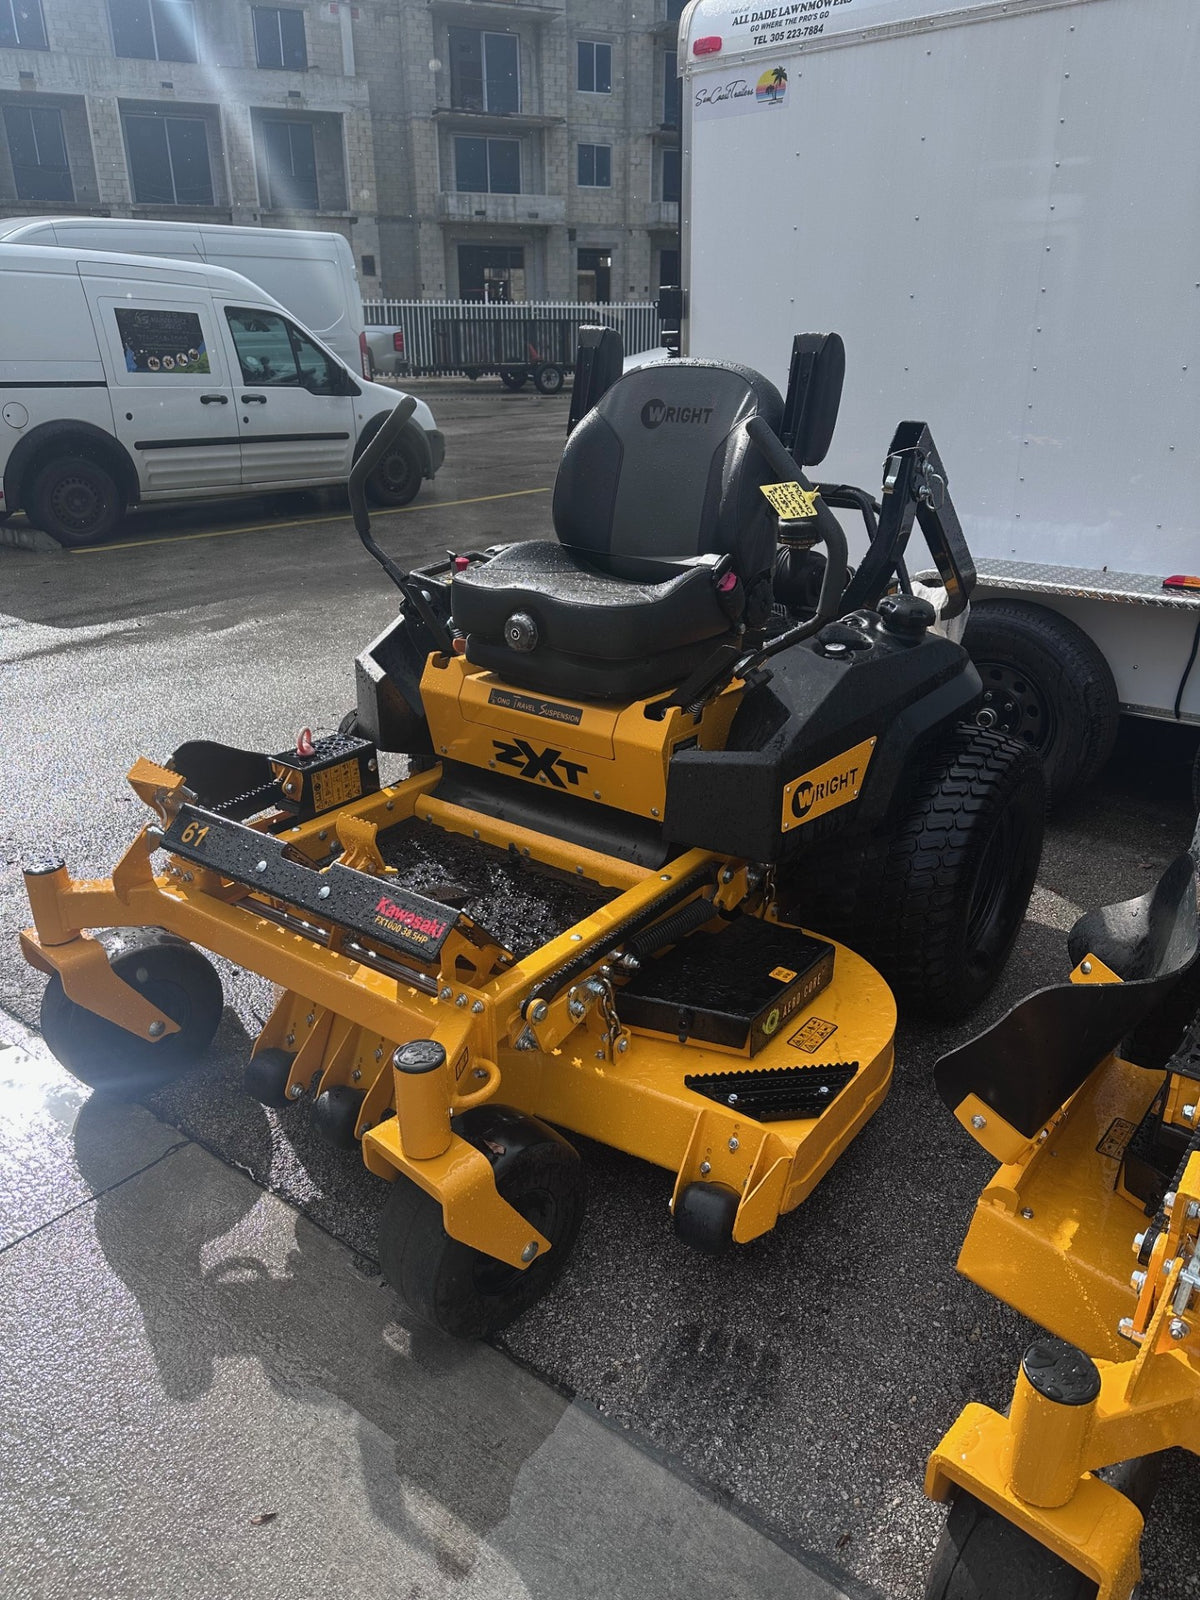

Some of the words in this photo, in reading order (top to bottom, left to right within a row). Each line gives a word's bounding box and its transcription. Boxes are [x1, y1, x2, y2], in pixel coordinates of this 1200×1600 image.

[732, 14, 750, 26] ALL
[750, 8, 778, 23] DADE
[750, 24, 760, 32] GO
[760, 20, 784, 30] WHERE
[784, 17, 798, 26] THE
[798, 13, 818, 23] PRO'S
[819, 10, 830, 19] GO
[753, 35, 768, 45] TEL
[769, 31, 785, 43] 305
[786, 24, 825, 39] 223-7884
[641, 398, 714, 429] WRIGHT
[513, 694, 535, 712] TRAVEL
[538, 703, 580, 723] SUSPENSION
[492, 738, 588, 790] ZXT
[792, 766, 859, 819] WRIGHT
[181, 821, 210, 847] 61
[375, 896, 447, 939] Kawasaki
